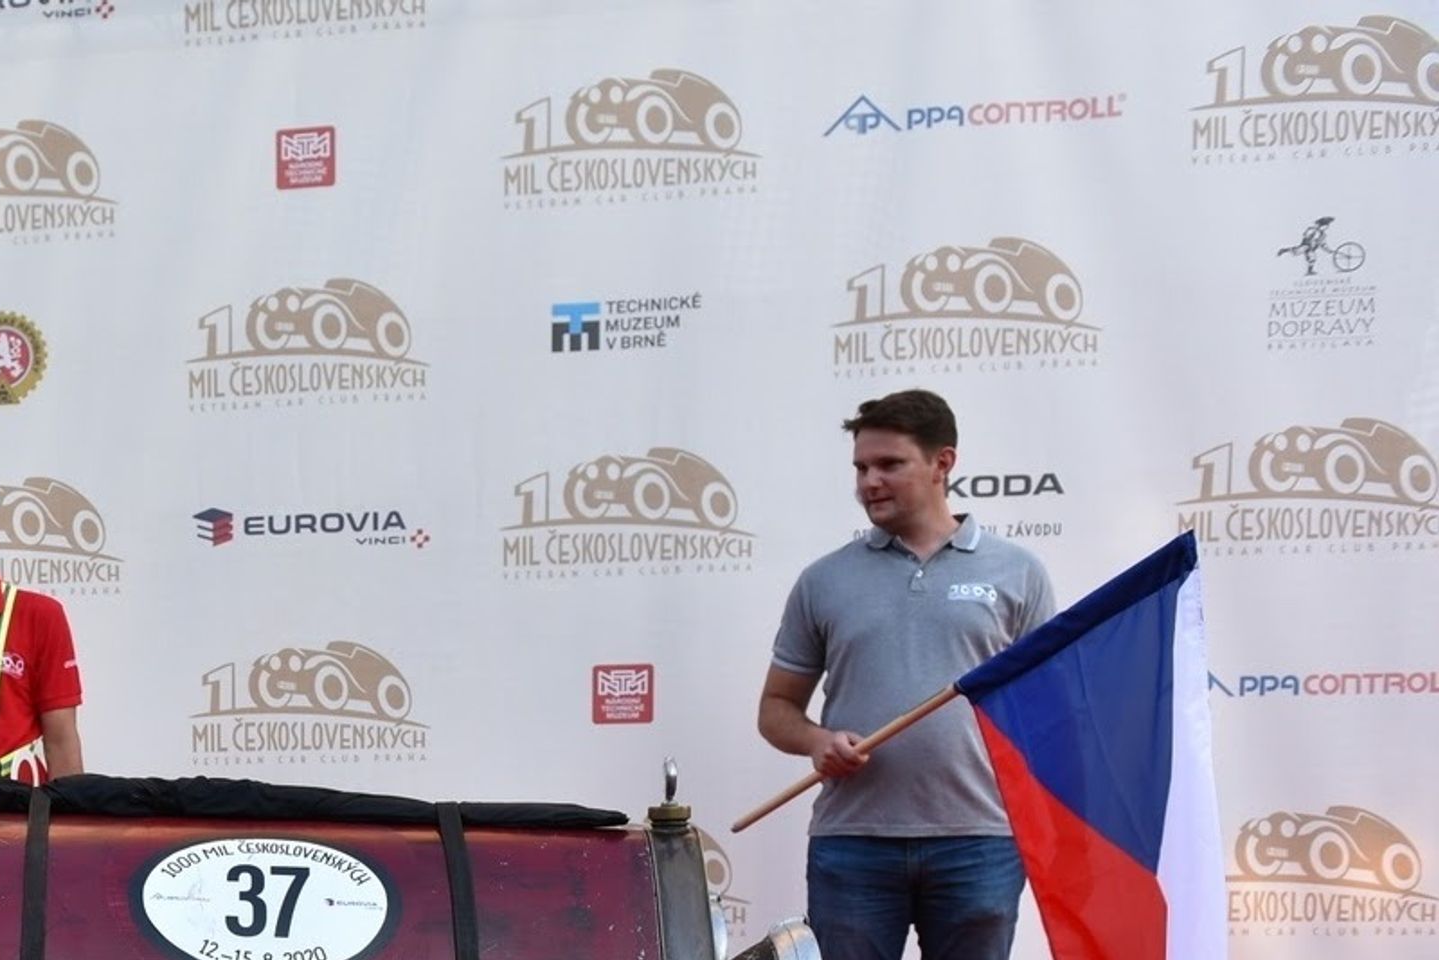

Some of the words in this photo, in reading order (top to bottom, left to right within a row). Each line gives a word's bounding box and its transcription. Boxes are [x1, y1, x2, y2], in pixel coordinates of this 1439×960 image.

[184, 0, 221, 34] MIL
[1192, 115, 1234, 151] MIL
[1240, 108, 1439, 148] ČESKOSLOVENSKÝ
[504, 164, 542, 196] MIL
[547, 157, 757, 193] ČESKOSLOVENSKÝCH
[605, 292, 702, 315] TECHNICKÉ
[605, 315, 681, 332] MUZEUM
[1267, 316, 1375, 338] DOPRAVY
[605, 337, 617, 350] V
[834, 332, 875, 365] MIL
[880, 323, 1098, 361] ČESKOSLOVENSKÝCH
[188, 368, 225, 399] MIL
[230, 361, 426, 396] ČESKOSLOVENSKÝCH
[947, 473, 1064, 498] KODA
[243, 510, 406, 536] EUROVIA
[1006, 520, 1062, 538] ZÁVODU
[355, 536, 406, 545] VINCI
[503, 534, 541, 567] MIL
[545, 529, 752, 565] ČESKOSLOVENSKÝCH
[192, 721, 228, 752] MIL
[232, 718, 426, 752] ČESKOSLOVENSKÝCH
[160, 852, 202, 878] 1000
[202, 845, 235, 860] MIL
[237, 840, 372, 886] ČESKOSLOVENSKÝCH
[225, 864, 310, 938] 37
[1228, 890, 1437, 923] ESKOSLOVENSKÝCH
